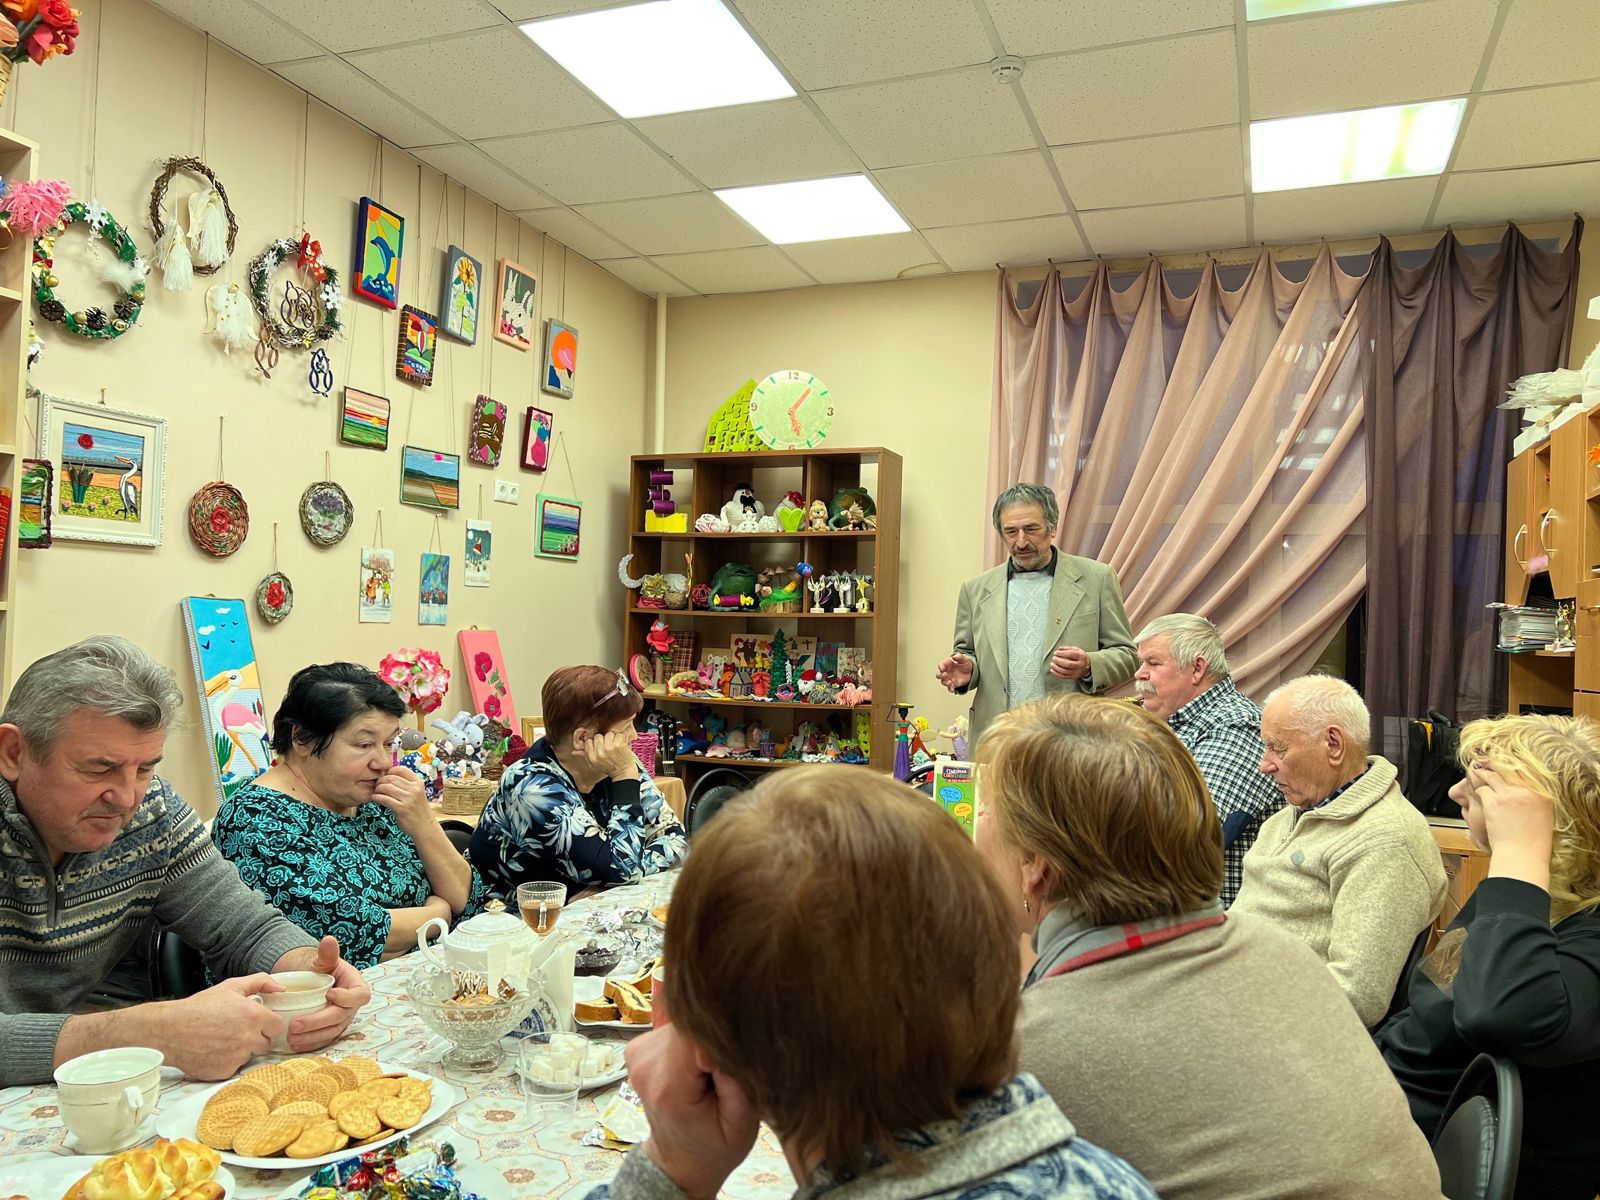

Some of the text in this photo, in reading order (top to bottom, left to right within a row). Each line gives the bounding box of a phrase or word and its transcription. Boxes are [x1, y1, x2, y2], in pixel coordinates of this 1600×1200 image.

[788, 371, 799, 380] 12
[751, 403, 757, 411] 9
[827, 407, 834, 416] 3
